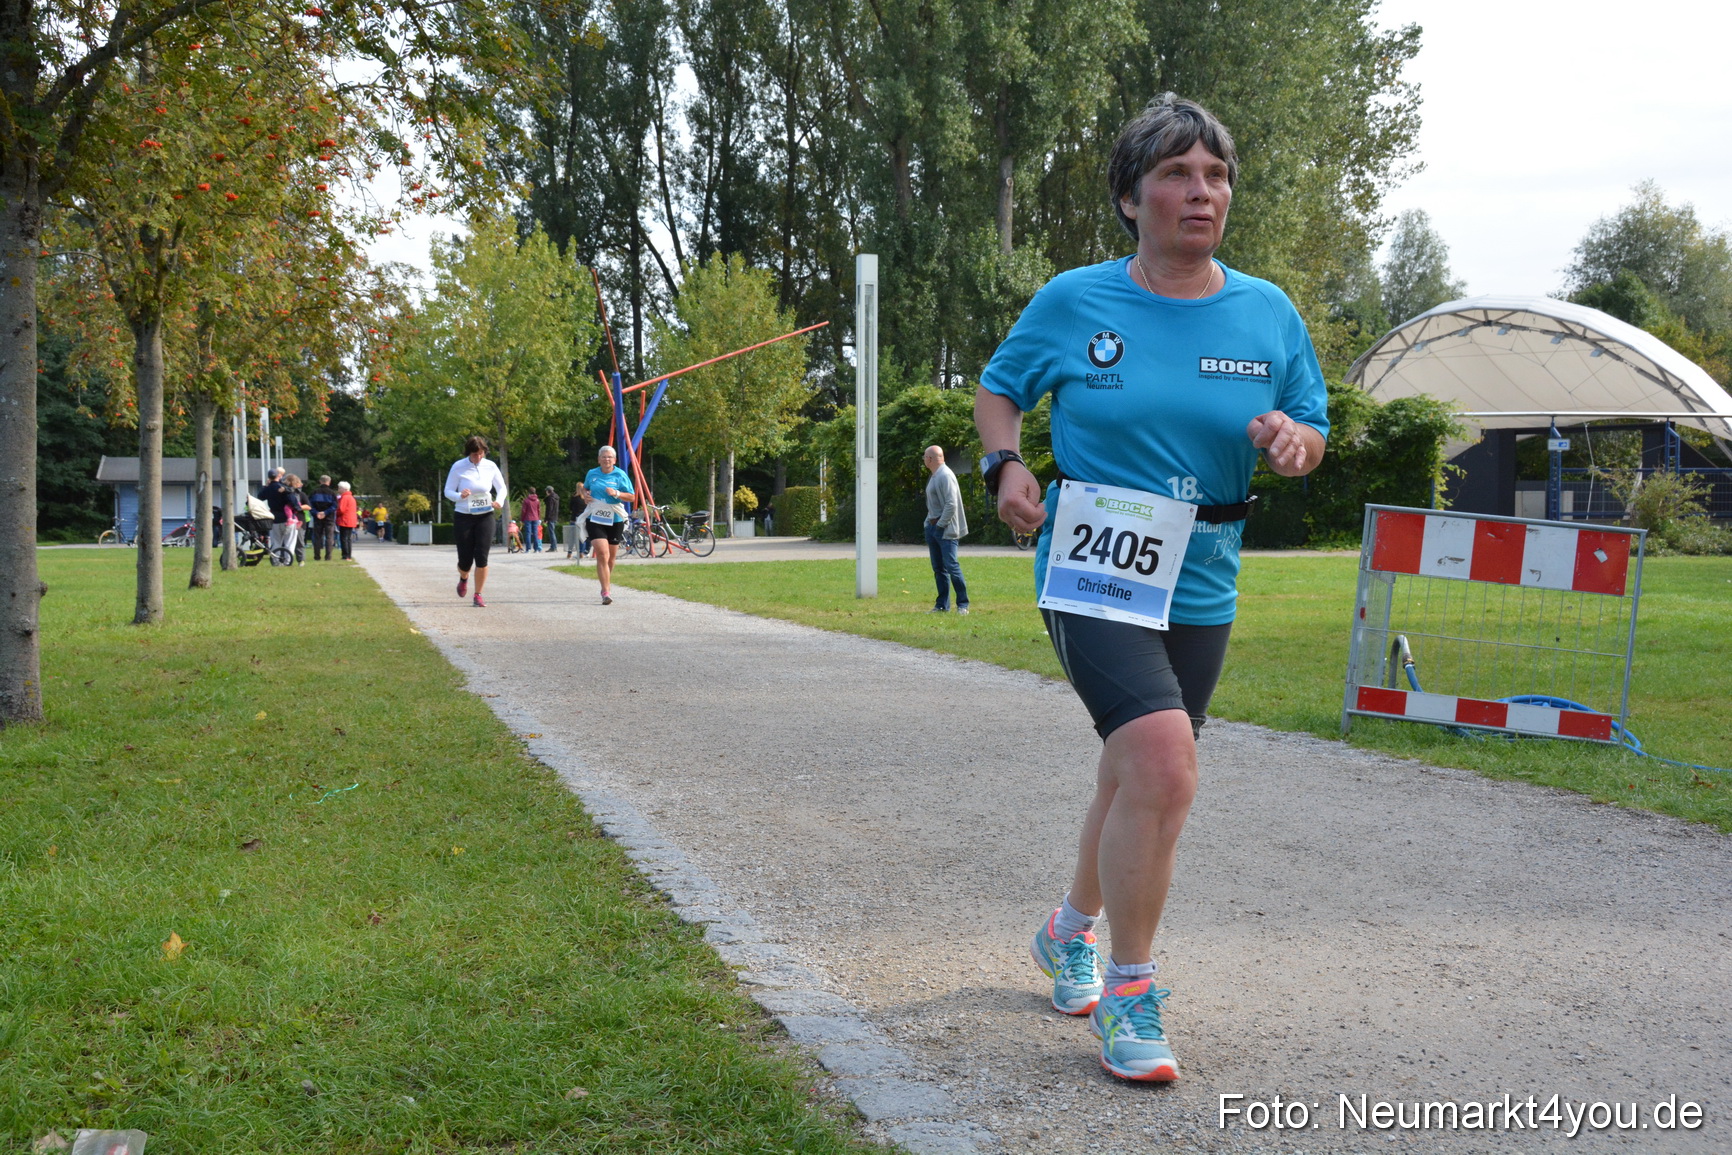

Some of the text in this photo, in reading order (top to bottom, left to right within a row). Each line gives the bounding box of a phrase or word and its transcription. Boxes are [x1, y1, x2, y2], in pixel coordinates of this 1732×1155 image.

[1090, 332, 1122, 345] BMW
[1200, 357, 1271, 377] BOCK
[1086, 373, 1124, 383] PARTL
[1086, 382, 1123, 390] Neumarkt
[1167, 476, 1203, 500] 18.
[1107, 499, 1154, 517] BOCK
[1068, 524, 1163, 576] 2405
[1077, 577, 1132, 601] Christine
